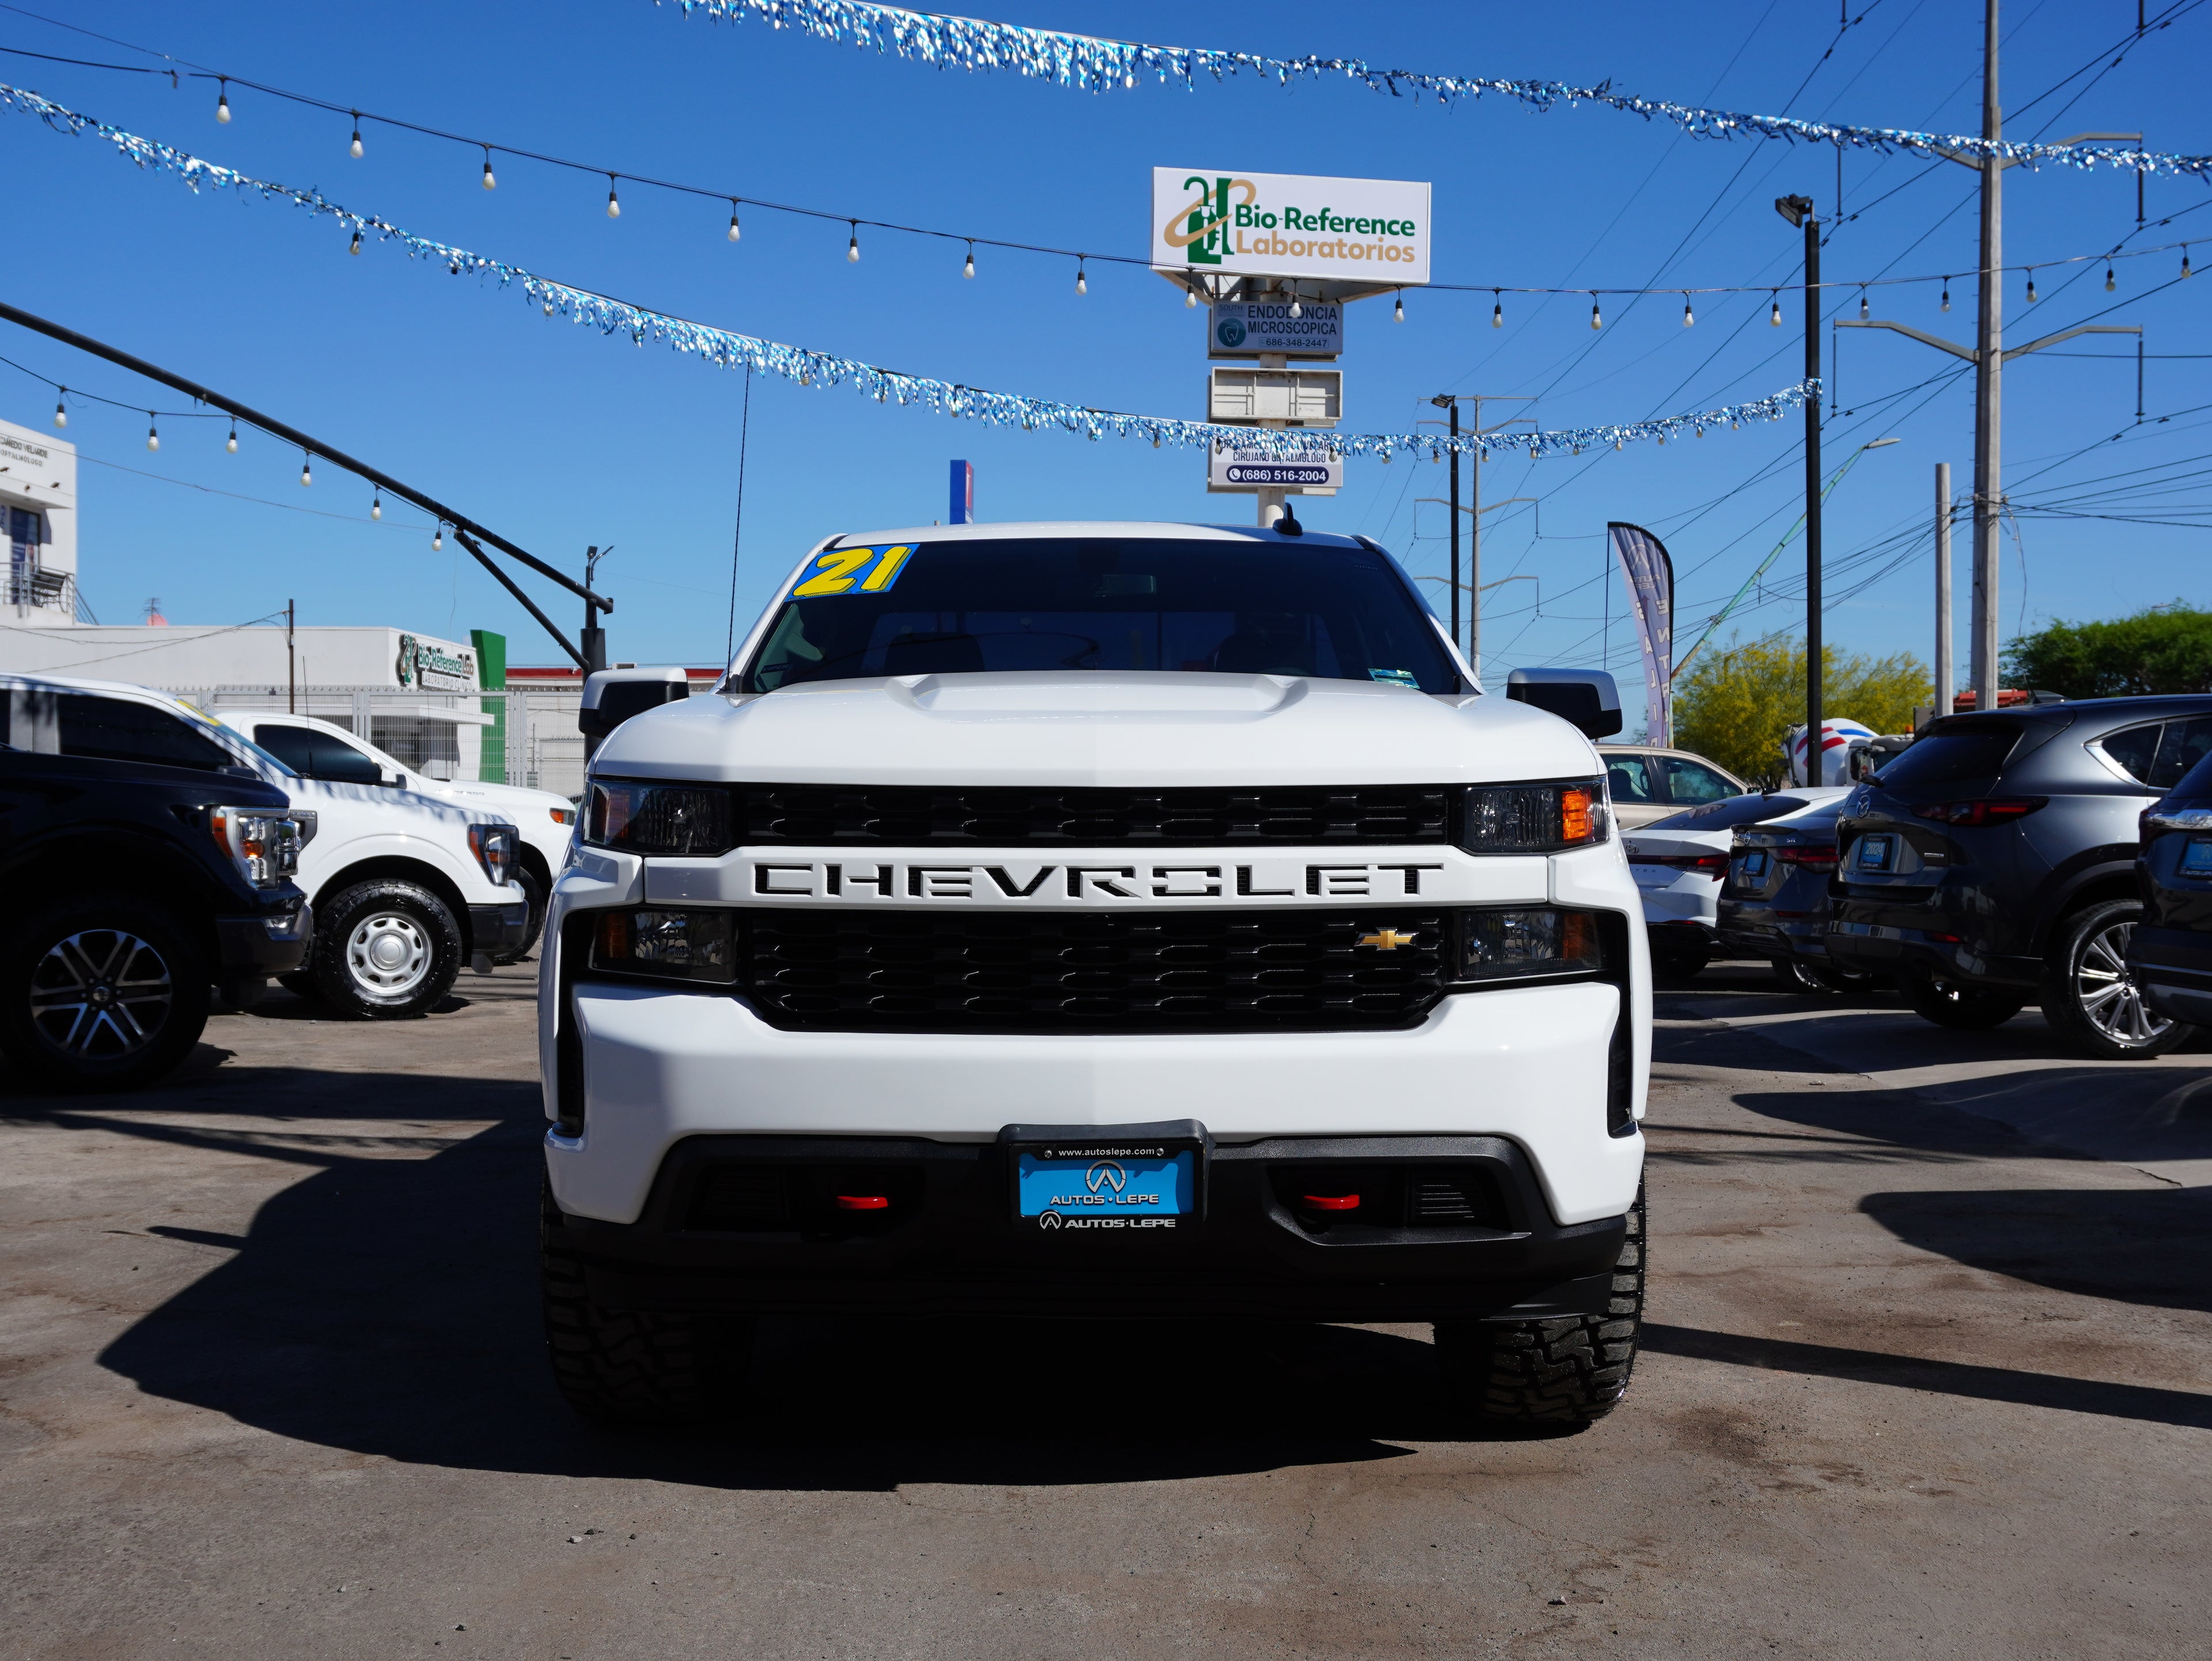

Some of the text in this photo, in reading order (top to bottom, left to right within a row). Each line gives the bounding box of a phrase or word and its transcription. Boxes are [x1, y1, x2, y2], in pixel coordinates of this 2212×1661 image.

[1235, 203, 1415, 236] Bio-Reference
[1236, 230, 1415, 263] Laboratorios
[1248, 321, 1337, 335] MICROSCOPICA
[1266, 338, 1327, 347] 686-348-2447
[1233, 452, 1270, 461] CIRUJANO
[1242, 469, 1326, 482] (686) 516-2004
[793, 546, 912, 597] 21
[463, 656, 474, 676] Lab
[422, 674, 453, 687] LABORATORIO
[1865, 843, 1884, 857] 2024
[754, 862, 1445, 898] CHEVROLET
[1059, 1147, 1155, 1157] www.autoslepe.com
